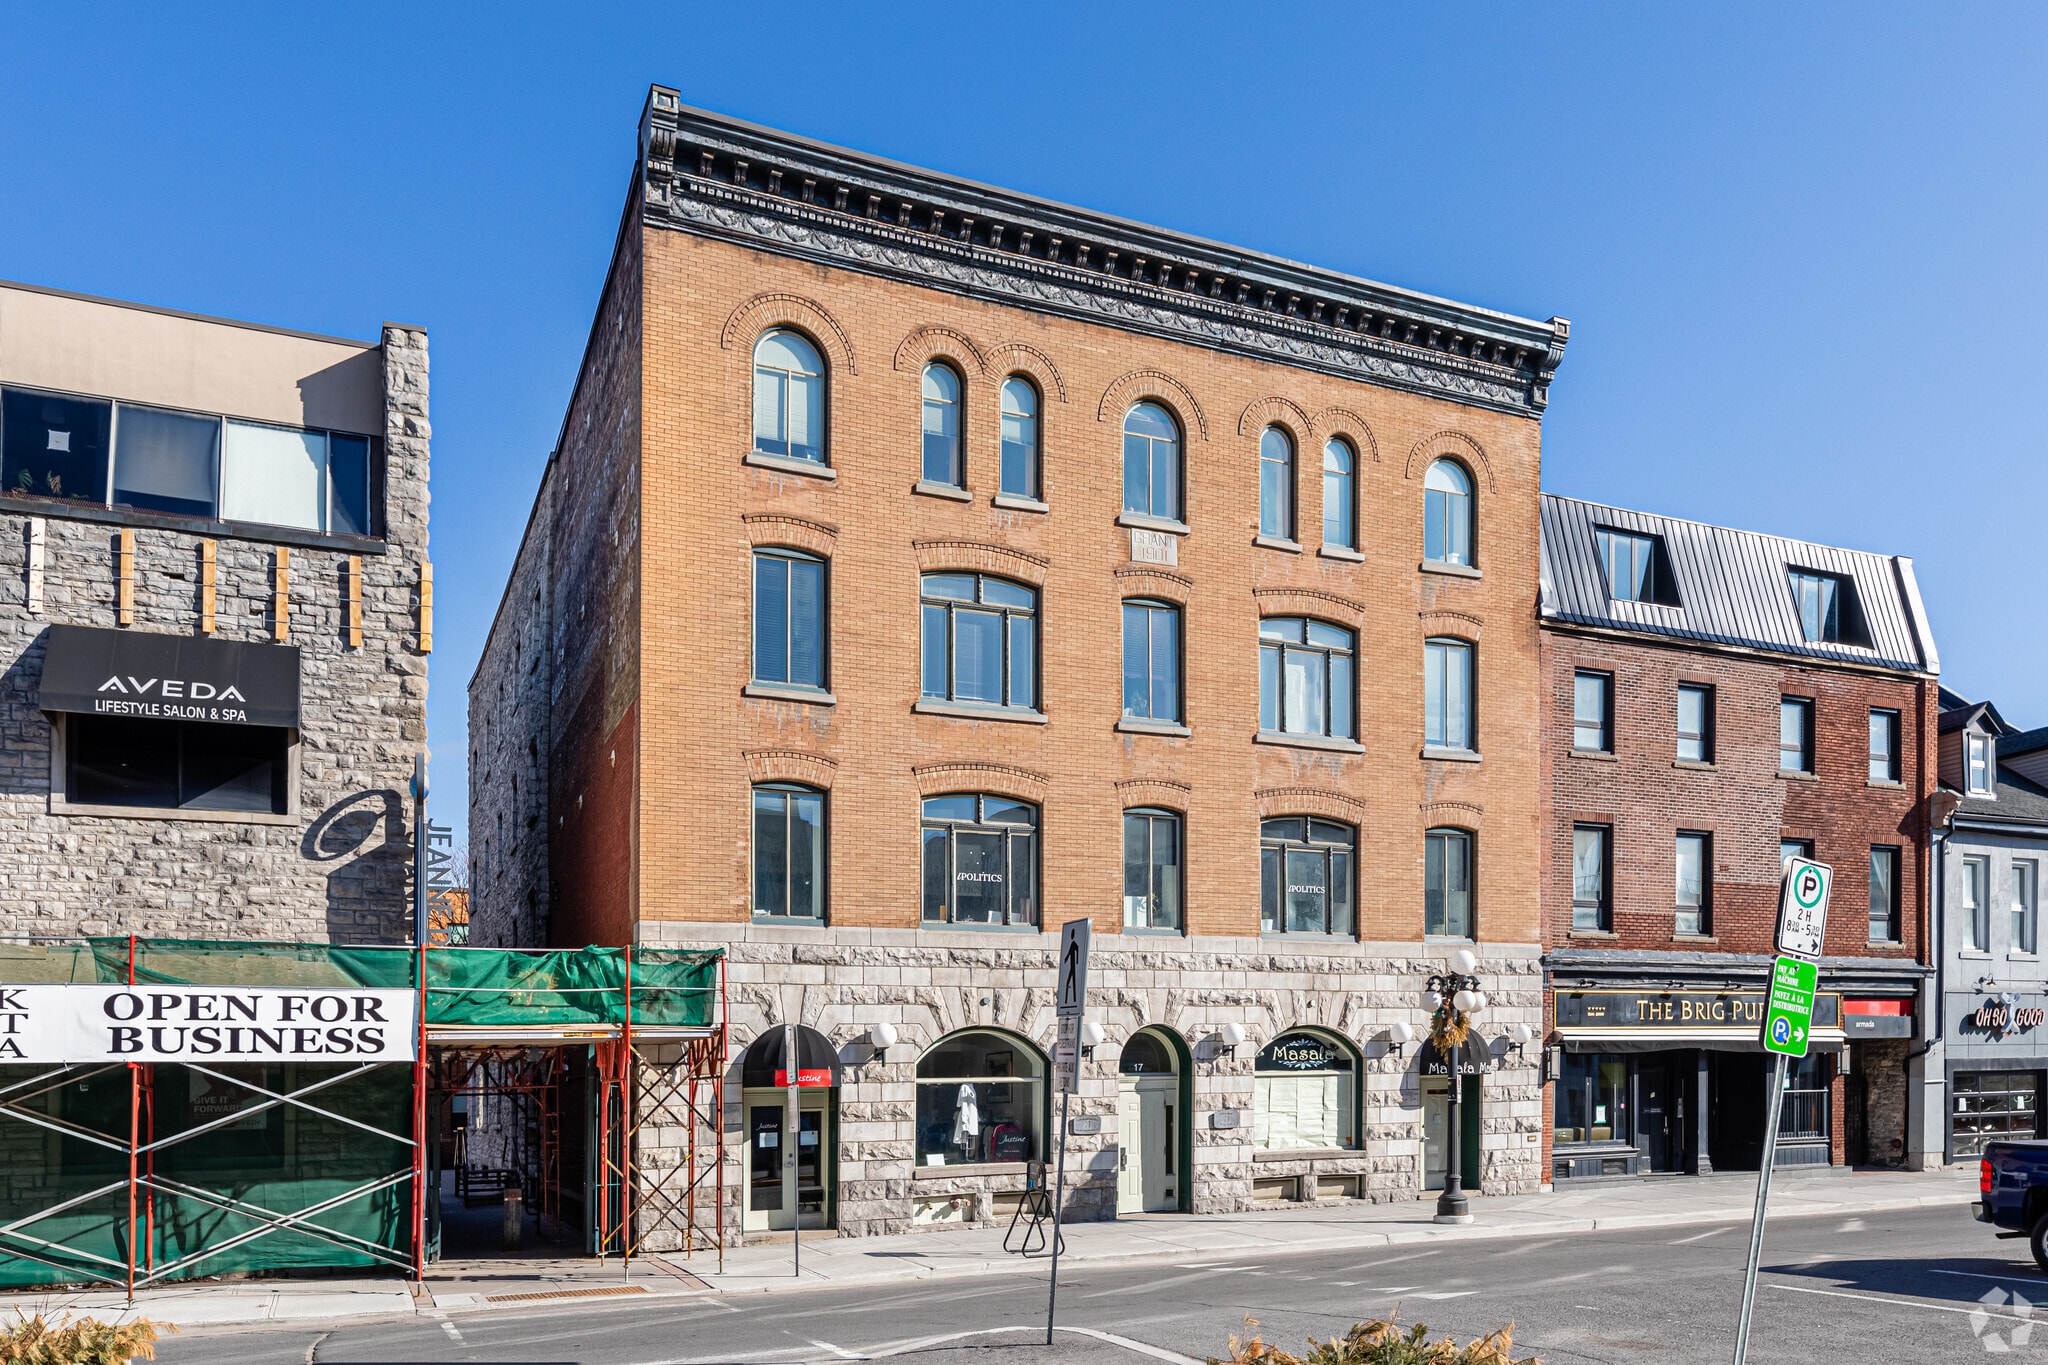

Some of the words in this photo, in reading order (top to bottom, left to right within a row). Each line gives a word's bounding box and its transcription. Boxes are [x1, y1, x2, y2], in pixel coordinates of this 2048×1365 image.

[1134, 531, 1176, 548] GRANT
[97, 675, 247, 703] AVEDA
[95, 699, 160, 716] LIFESTYLE
[163, 704, 206, 719] SALON
[210, 708, 219, 720] &
[222, 708, 247, 722] SPA
[1803, 876, 1817, 897] P
[1774, 990, 1791, 1001] PAYEZ
[103, 992, 264, 1021] OPEN
[277, 995, 389, 1023] FOR
[1637, 1000, 1674, 1021] THE
[1681, 1000, 1726, 1021] BRIG
[1855, 1020, 1875, 1028] armada
[2016, 1008, 2045, 1027] GOOD
[106, 1026, 387, 1054] BUSINESS
[1272, 1045, 1335, 1061] Masala
[1133, 1063, 1143, 1072] 17
[1428, 1061, 1475, 1074] Maala
[798, 1074, 822, 1083] stine
[193, 1096, 217, 1105] GIVE
[219, 1096, 229, 1104] IT
[998, 1134, 1026, 1144] Justine
